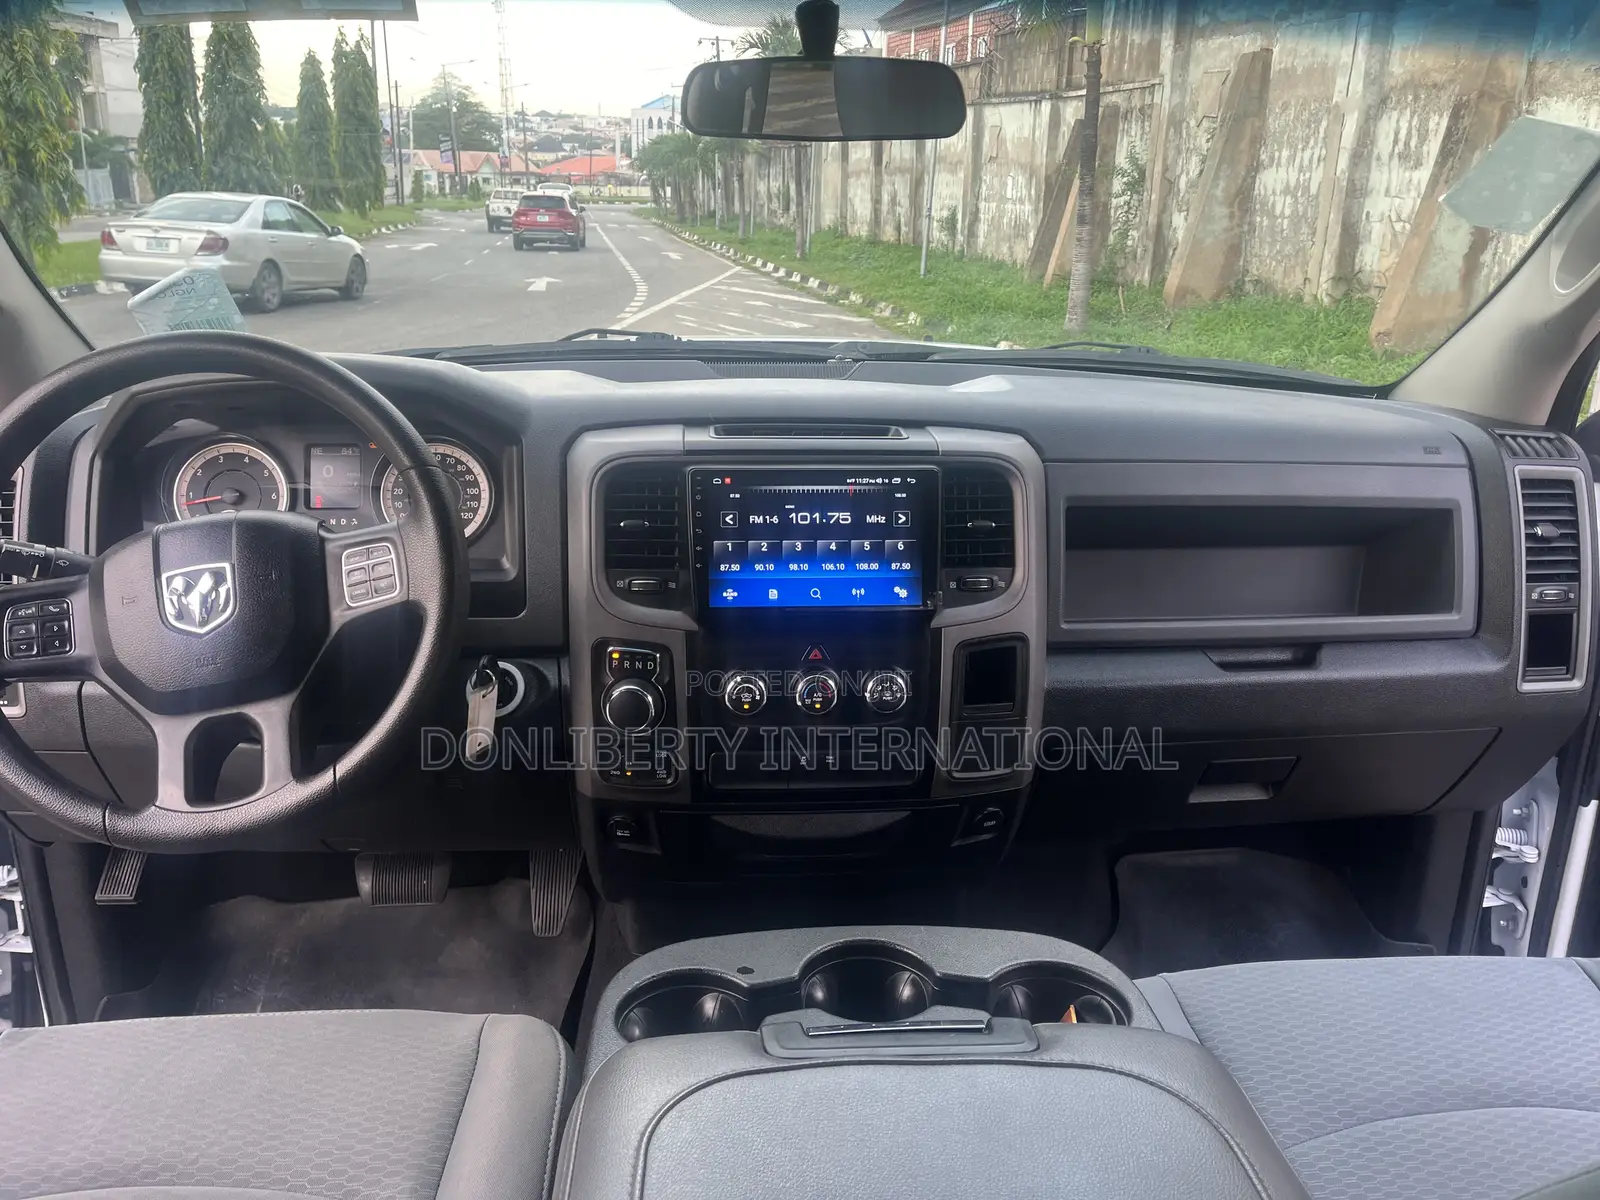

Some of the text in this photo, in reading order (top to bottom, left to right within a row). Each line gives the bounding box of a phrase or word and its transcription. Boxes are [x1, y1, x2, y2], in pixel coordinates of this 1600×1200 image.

[196, 468, 202, 476] 2
[456, 464, 467, 472] 80
[263, 469, 269, 477] 5
[749, 515, 779, 524] FM 1-6
[788, 512, 852, 525] 101.75
[866, 515, 886, 524] MHz
[726, 543, 732, 551] 1
[760, 543, 768, 551] 2
[795, 542, 802, 551] 3
[829, 542, 837, 551] 4
[863, 542, 871, 550] 5
[897, 541, 904, 550] 6
[719, 563, 741, 572] 87.50
[754, 563, 775, 571] 90.10
[788, 563, 809, 571] 98.10
[821, 563, 845, 571] 106.10
[855, 563, 879, 571] 108.00
[891, 562, 911, 570] 87.50
[612, 660, 655, 670] P R N D
